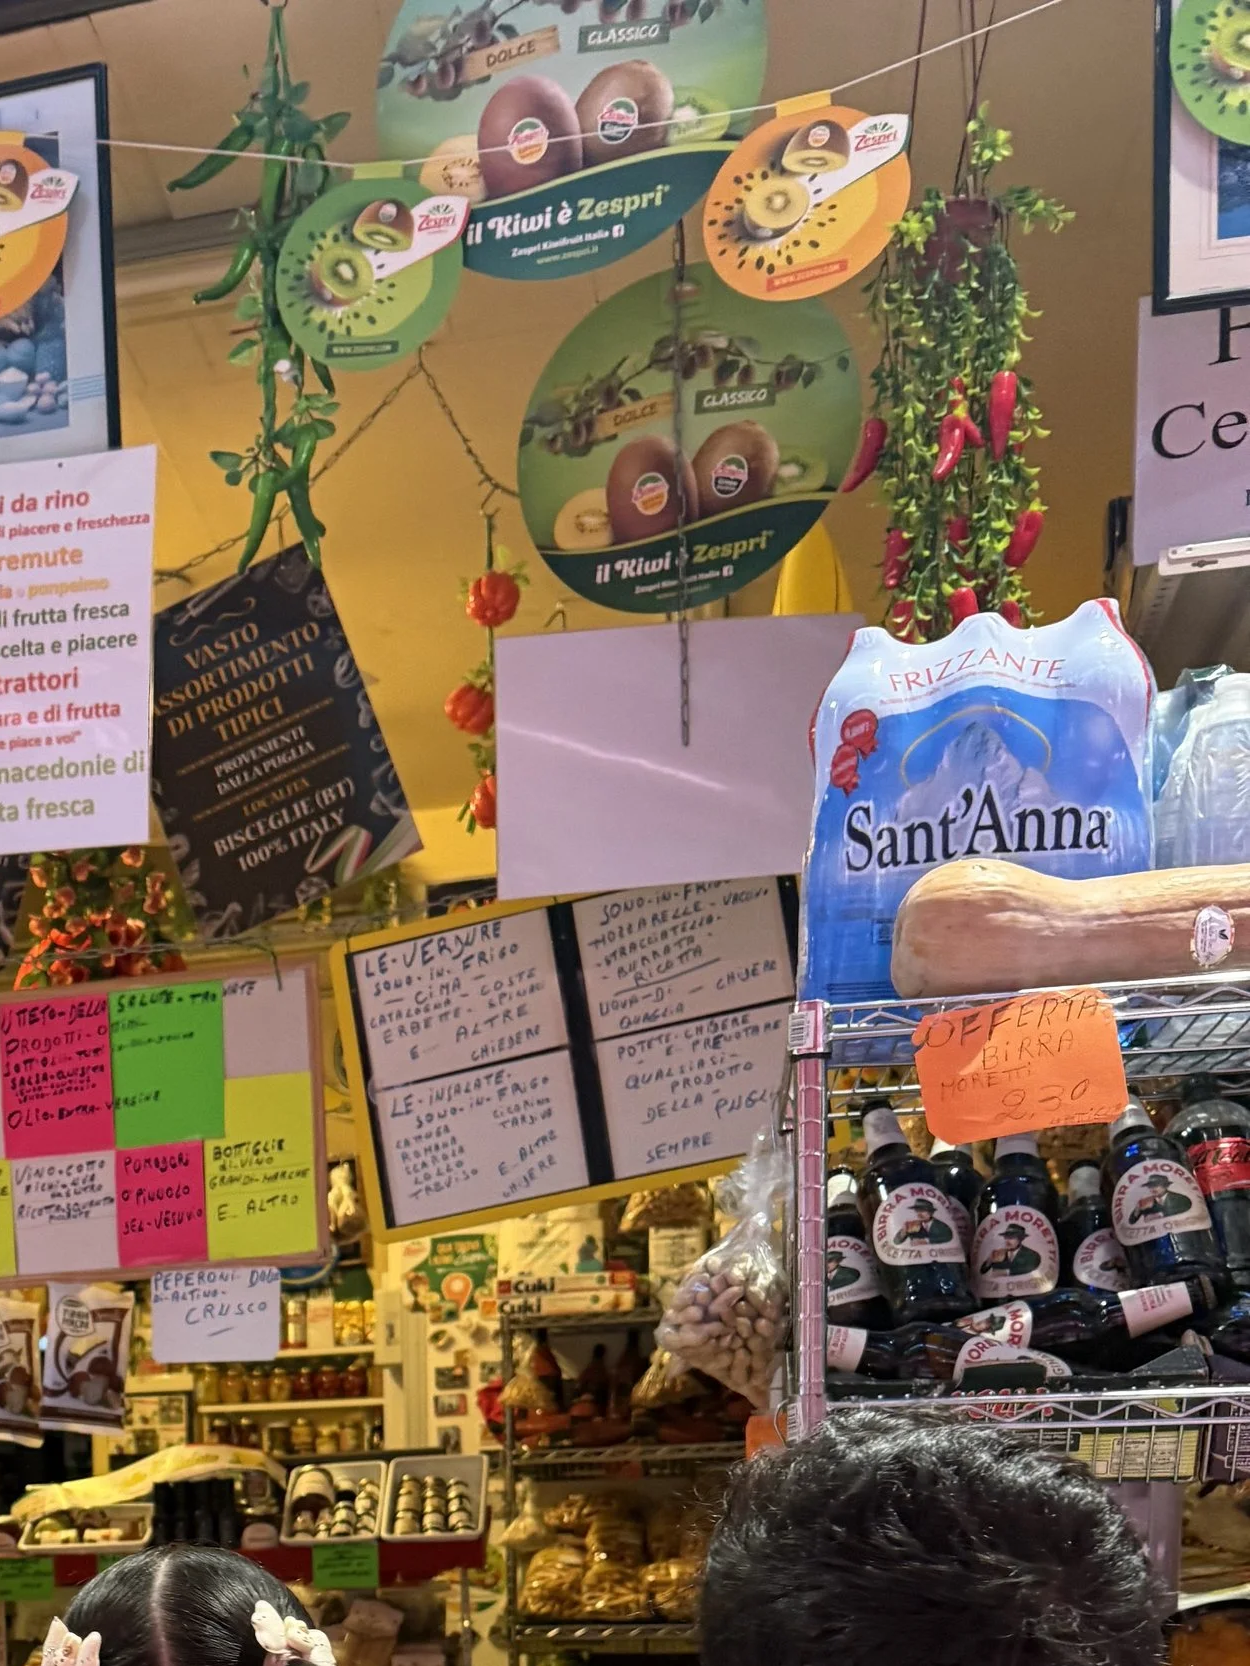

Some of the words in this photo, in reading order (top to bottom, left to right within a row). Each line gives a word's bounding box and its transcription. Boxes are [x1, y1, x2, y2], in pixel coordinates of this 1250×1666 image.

[486, 41, 536, 68] DOLCE
[587, 22, 660, 45] CLASSICO
[854, 130, 898, 152] Zespri
[466, 221, 482, 246] il
[486, 206, 552, 239] Kiwi
[557, 200, 571, 226] è
[613, 402, 658, 426] DOLCE
[702, 388, 768, 408] CLASSICO
[11, 493, 37, 514] da
[45, 489, 90, 510] rino
[8, 520, 60, 539] piacere
[64, 521, 73, 532] e
[76, 511, 150, 531] freschezza
[595, 564, 610, 584] il
[614, 551, 671, 580] Kiwi
[13, 605, 67, 627] frutta
[73, 601, 130, 621] fresca
[50, 640, 62, 654] e
[67, 631, 138, 656] piacere
[183, 621, 260, 671] VASTO
[888, 647, 1068, 693] FRIZZANTE
[26, 710, 38, 725] e
[43, 704, 61, 722] di
[66, 701, 121, 721] frutta
[166, 712, 193, 738] DI
[196, 652, 315, 724] PRODOTTI
[213, 695, 284, 742] TIPICI
[123, 750, 145, 773] di
[26, 796, 96, 820] fresca
[213, 797, 316, 858] BISCEGLIE
[314, 776, 357, 813] (BT)
[237, 838, 289, 873] 100%
[290, 807, 345, 848] ITALY
[845, 784, 1111, 872] Sant'Anna
[923, 988, 1099, 1049] OFFERTA
[876, 1192, 906, 1244] BIRRA
[512, 1277, 555, 1293] Cuki
[499, 1298, 542, 1315] Cuki
